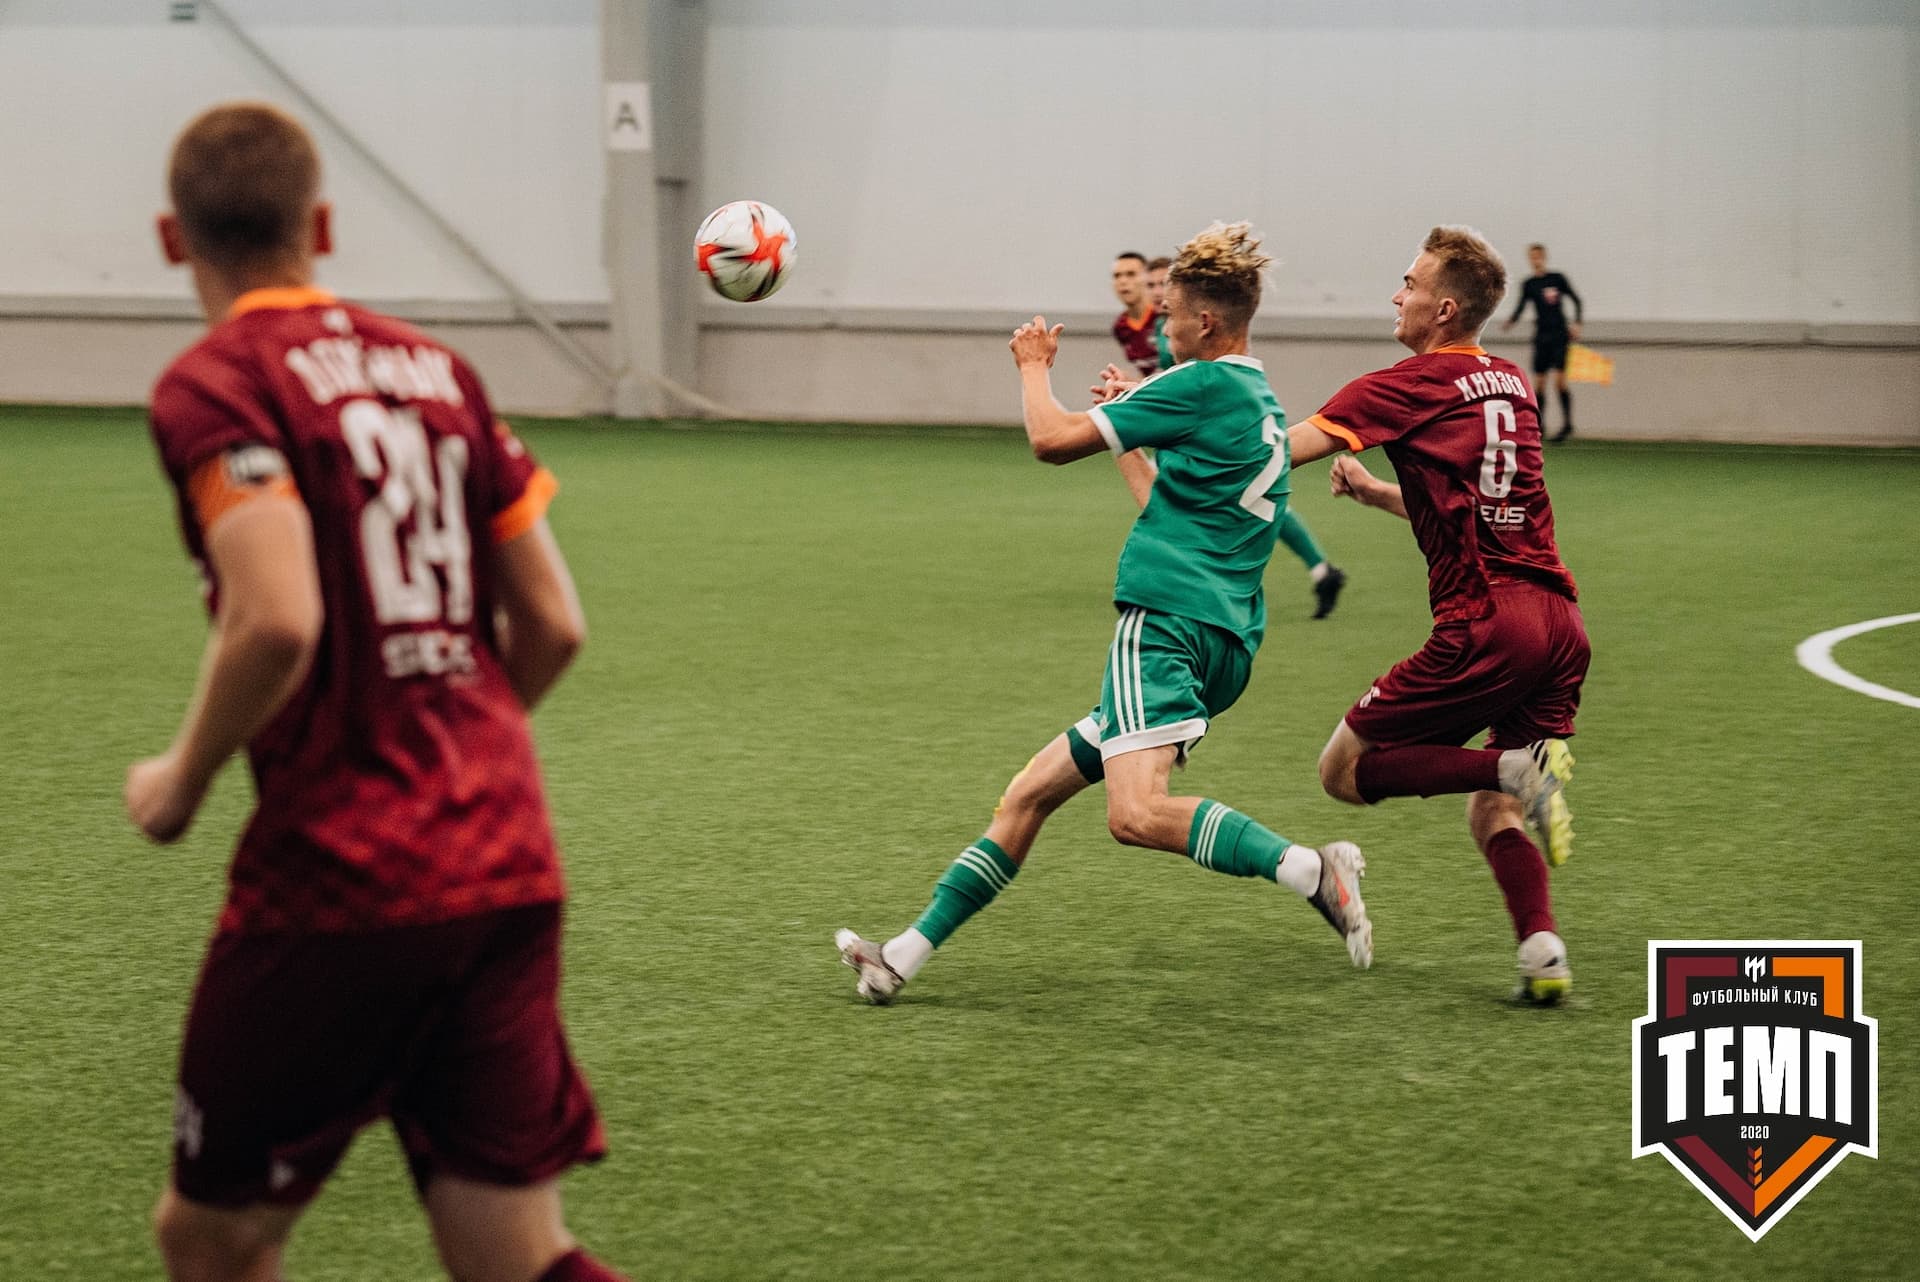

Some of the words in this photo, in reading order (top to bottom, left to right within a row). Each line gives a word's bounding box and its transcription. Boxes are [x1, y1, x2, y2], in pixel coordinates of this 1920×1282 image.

[1239, 414, 1286, 523] 2
[1479, 399, 1518, 498] 6
[340, 399, 473, 625] 24
